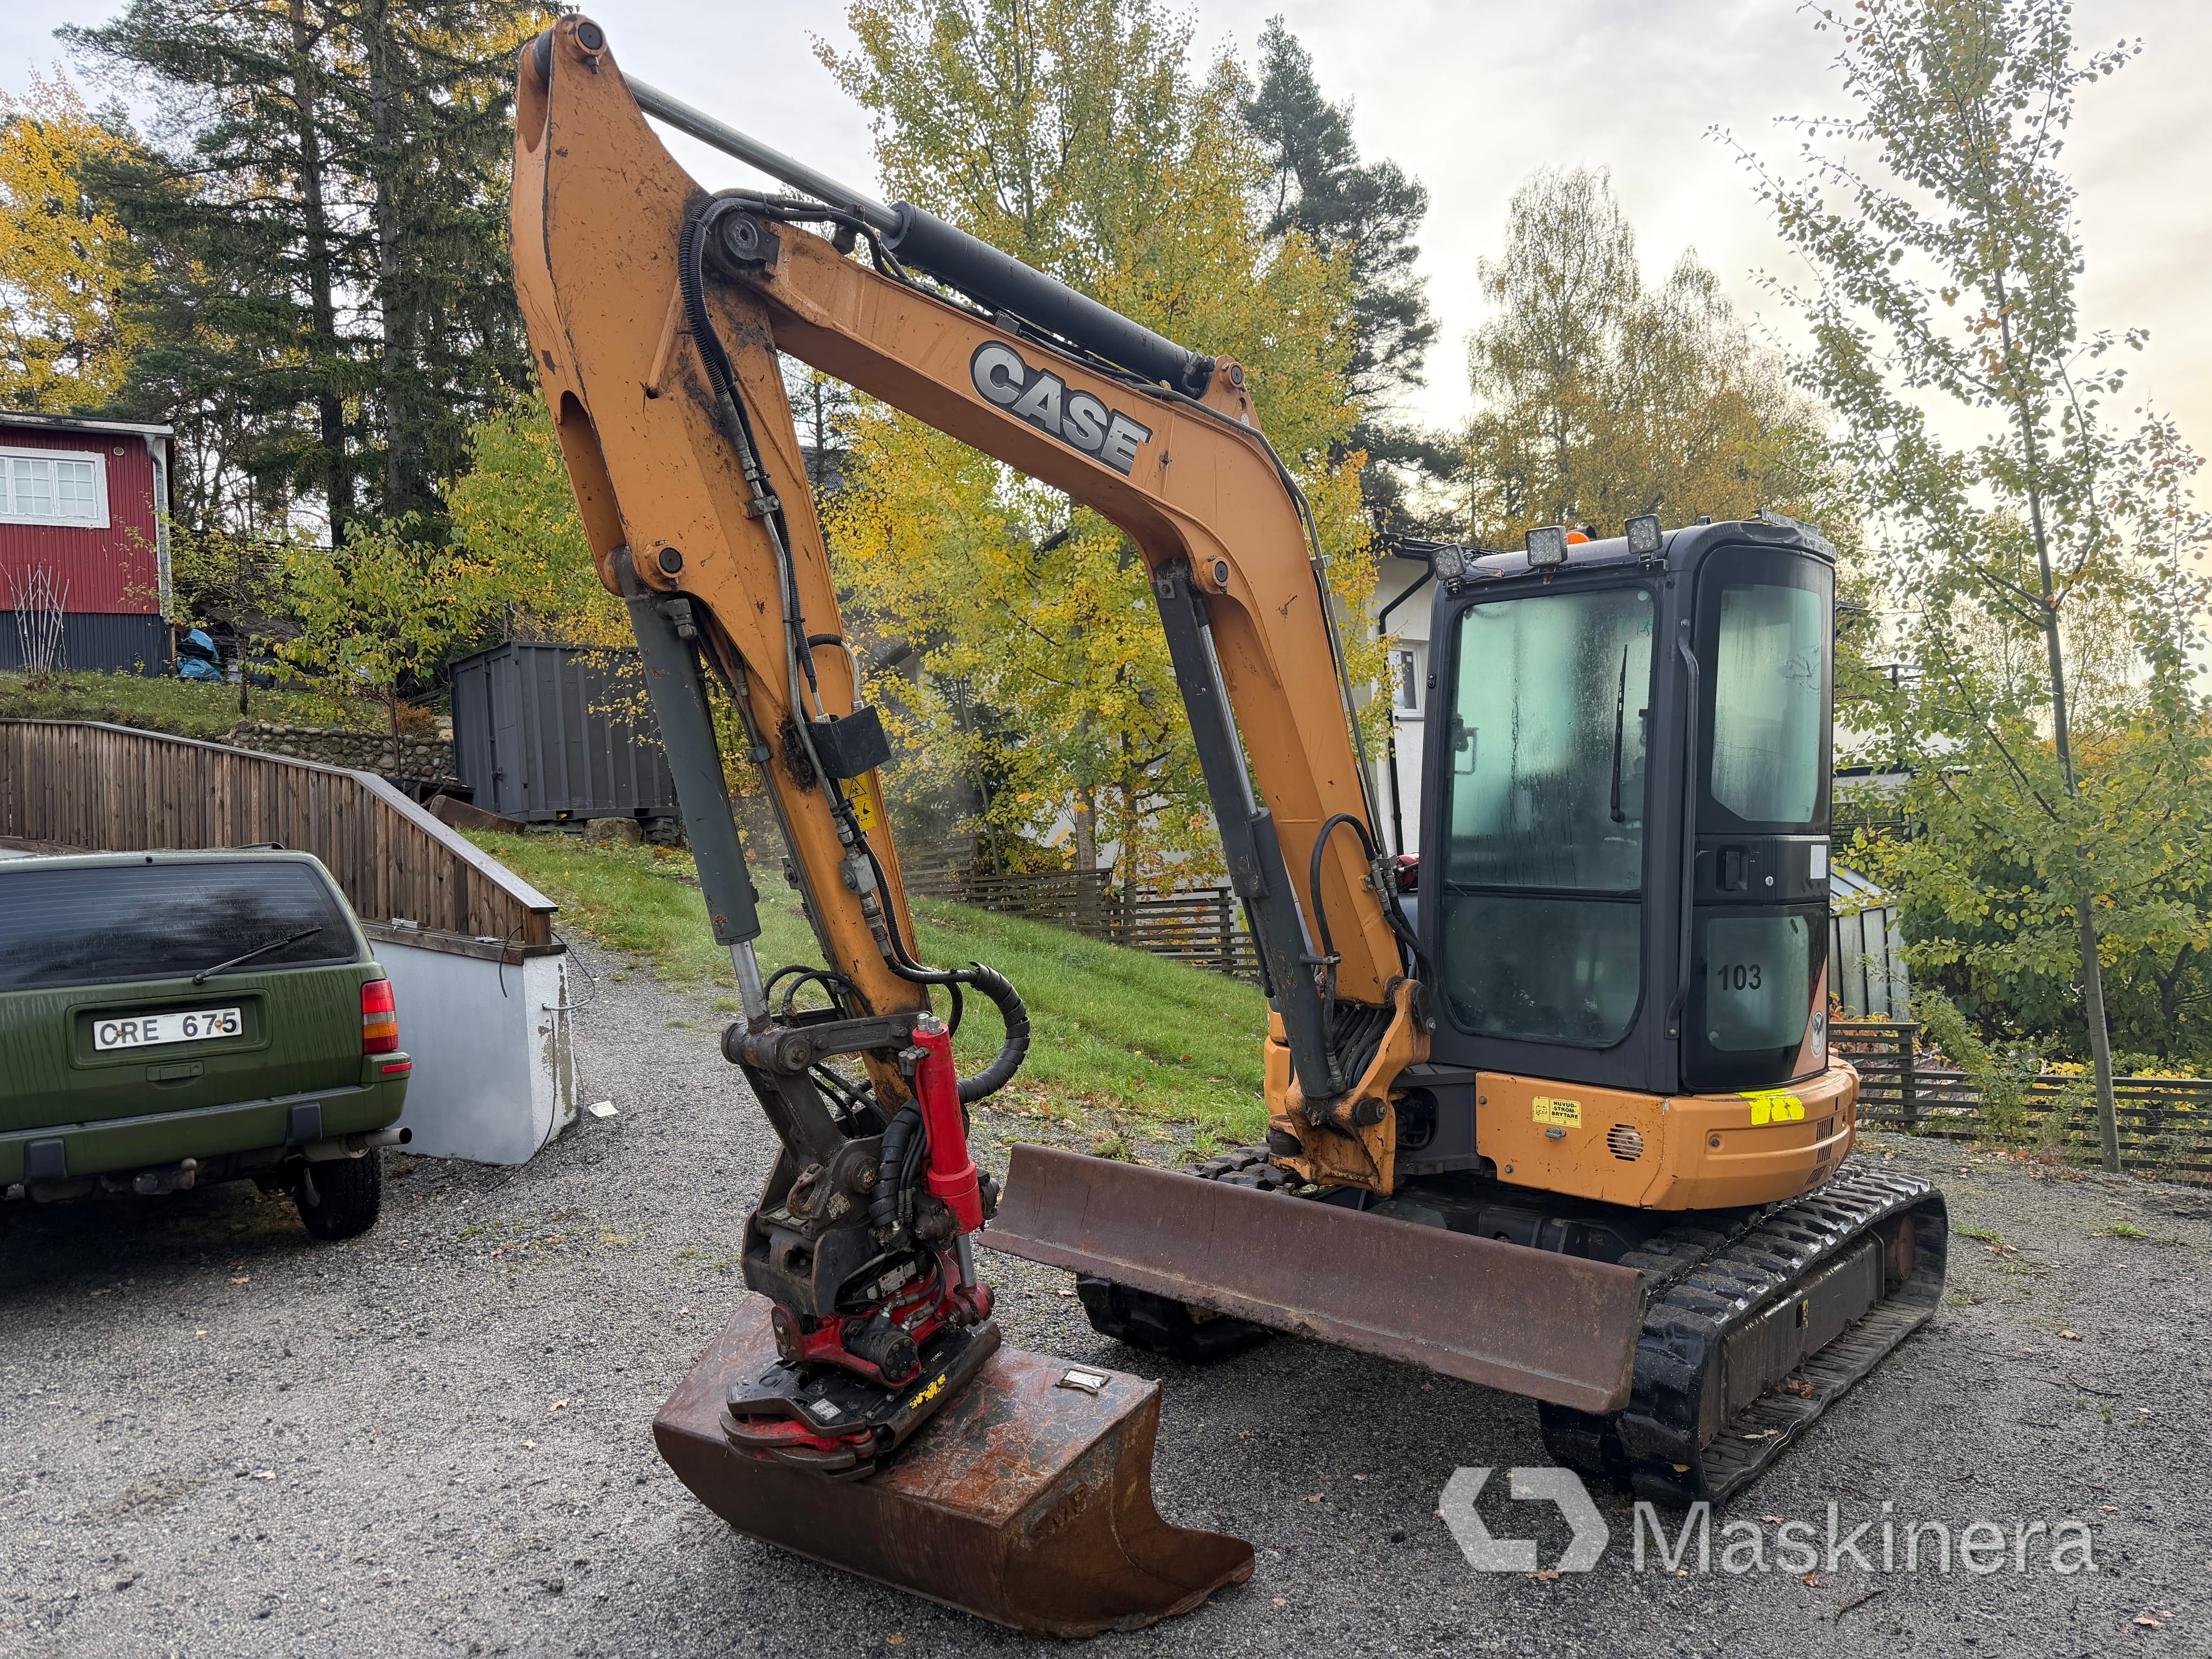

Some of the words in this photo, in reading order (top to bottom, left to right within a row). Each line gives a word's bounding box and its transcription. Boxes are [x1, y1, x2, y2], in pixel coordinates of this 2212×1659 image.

[971, 342, 1151, 474] CASE
[1718, 964, 1762, 991] 103
[100, 1019, 159, 1046] CRE
[182, 1012, 237, 1037] 675
[1552, 1111, 1579, 1119] BRYTARE
